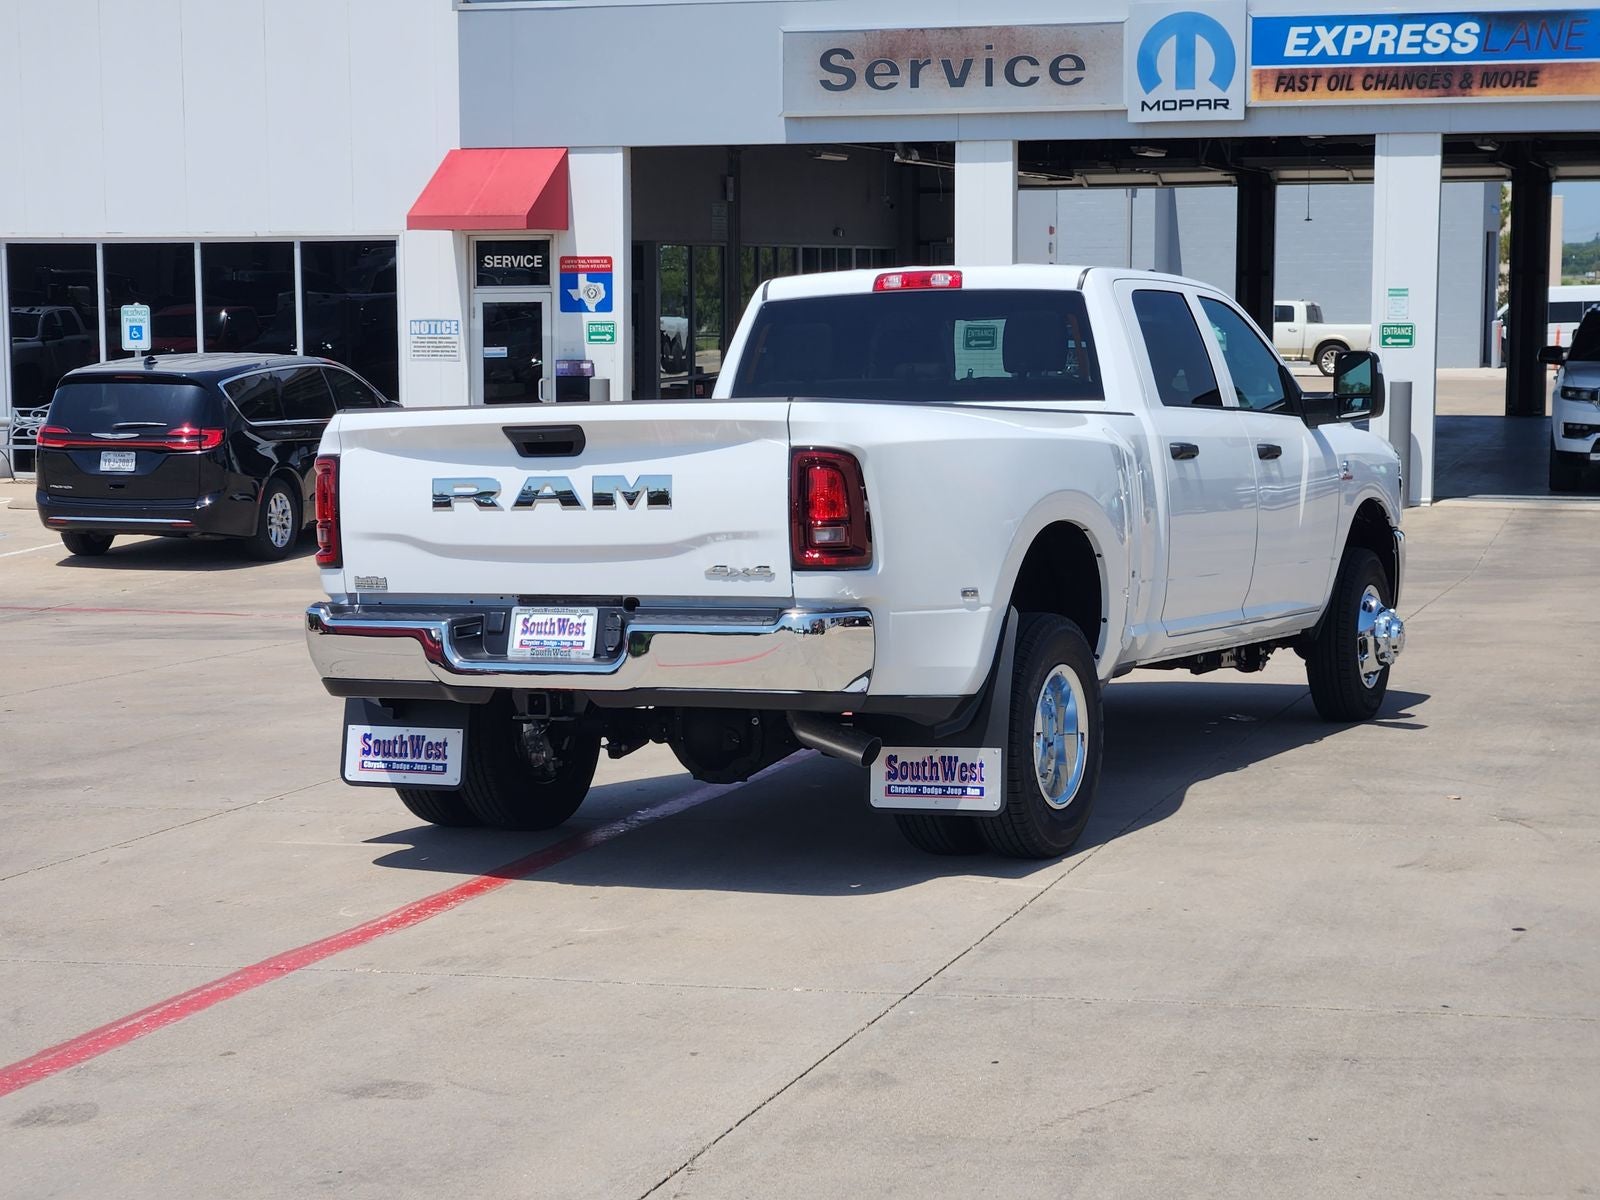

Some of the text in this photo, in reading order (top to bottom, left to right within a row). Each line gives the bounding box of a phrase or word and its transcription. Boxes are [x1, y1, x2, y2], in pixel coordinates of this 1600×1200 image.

[1283, 19, 1589, 57] EXPRESS LANE
[818, 44, 1086, 92] Service
[1274, 70, 1540, 93] FAST OIL CHANGES & MORE
[1140, 98, 1231, 113] MOPAR
[483, 255, 543, 268] SERVICE
[410, 320, 459, 334] NOTICE
[589, 324, 614, 333] ENTRANCE
[1383, 326, 1412, 336] ENTRANCE
[431, 474, 673, 512] RAM
[520, 616, 587, 636] SouthWest
[530, 648, 571, 657] SouthWest
[360, 732, 448, 761] SouthWest
[363, 761, 388, 769] Chrysler
[391, 762, 410, 770] Dodge
[413, 763, 427, 771] Jeep
[885, 754, 985, 783] SouthWest
[890, 785, 980, 796] Chrysler Dodge Jeep Ram
